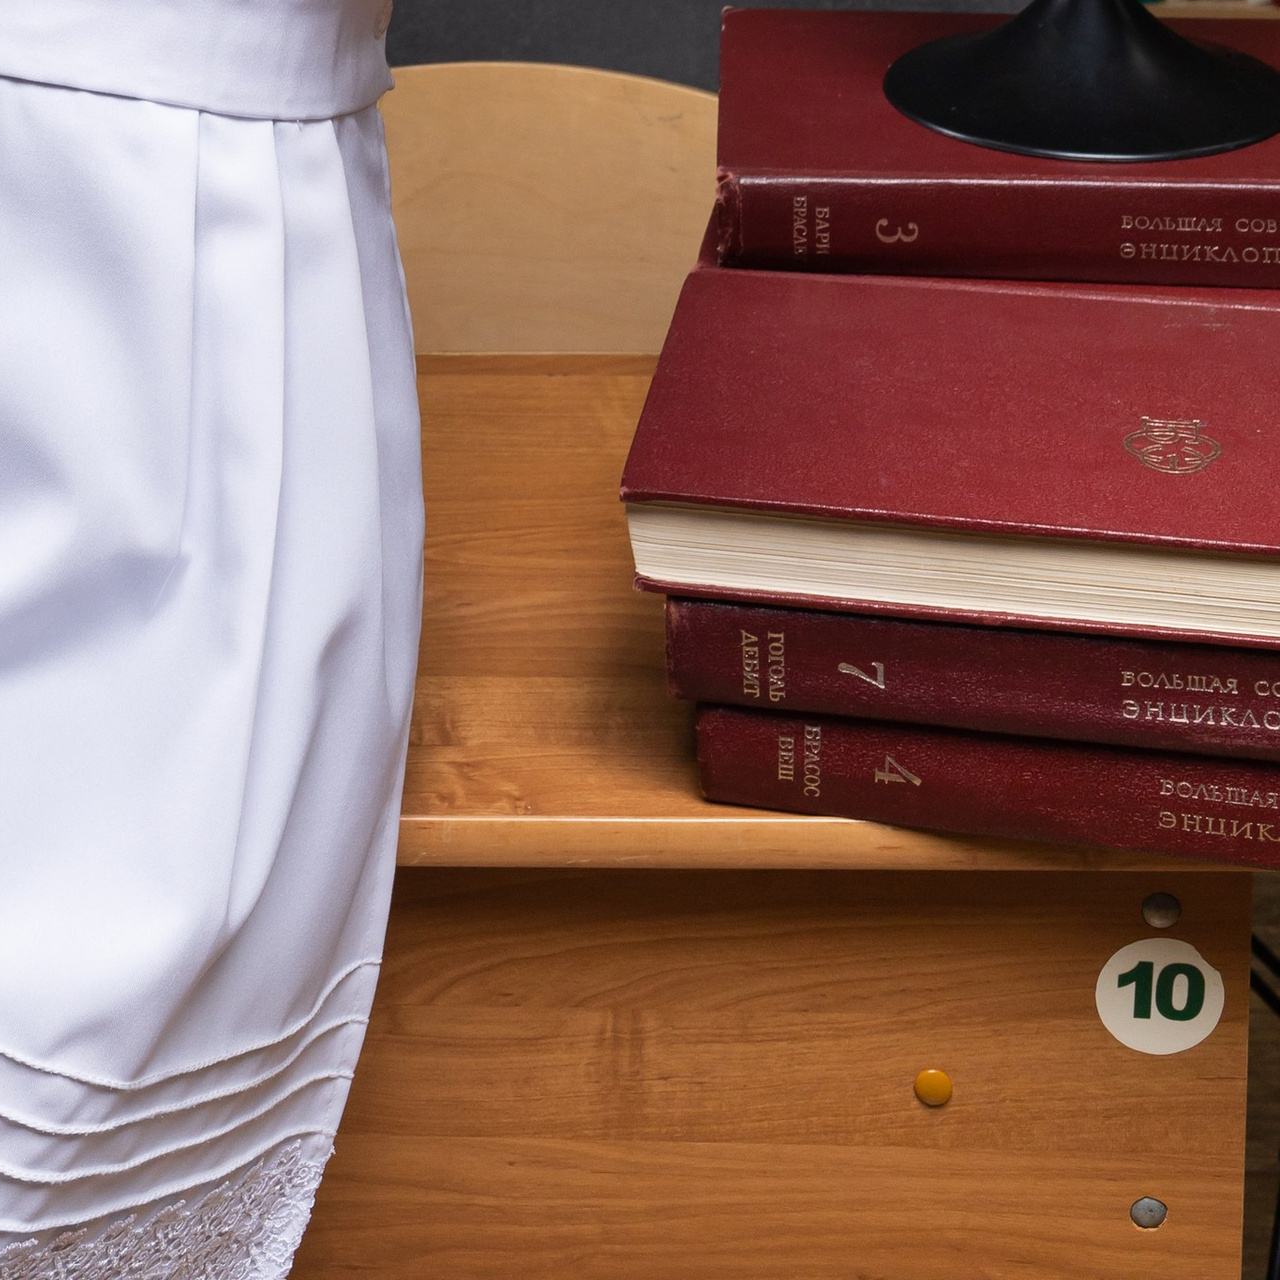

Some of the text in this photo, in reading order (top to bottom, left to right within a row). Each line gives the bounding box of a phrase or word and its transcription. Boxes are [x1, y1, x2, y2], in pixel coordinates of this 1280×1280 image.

[793, 195, 808, 262] БРАСЛЕ
[815, 206, 830, 255] БАРИ
[875, 218, 919, 244] 3
[1120, 214, 1277, 233] БОЛЬШАЯ СОВ
[1119, 242, 1280, 264] ЭНЦИКЛОП
[739, 629, 760, 698] ДЕБИТ
[767, 631, 787, 702] ГОГОЛЬ
[837, 661, 886, 689] 7
[1121, 670, 1239, 695] БОЛЬШАЯ
[1121, 700, 1280, 731] ЭНЦИКЛО
[778, 735, 794, 782] ВЕШ
[803, 724, 821, 797] БРАСОС
[874, 754, 923, 786] 4
[1159, 778, 1279, 810] БОЛЬШАЯ
[1158, 811, 1280, 842] ЭНЦИК
[1117, 960, 1206, 1022] 10
